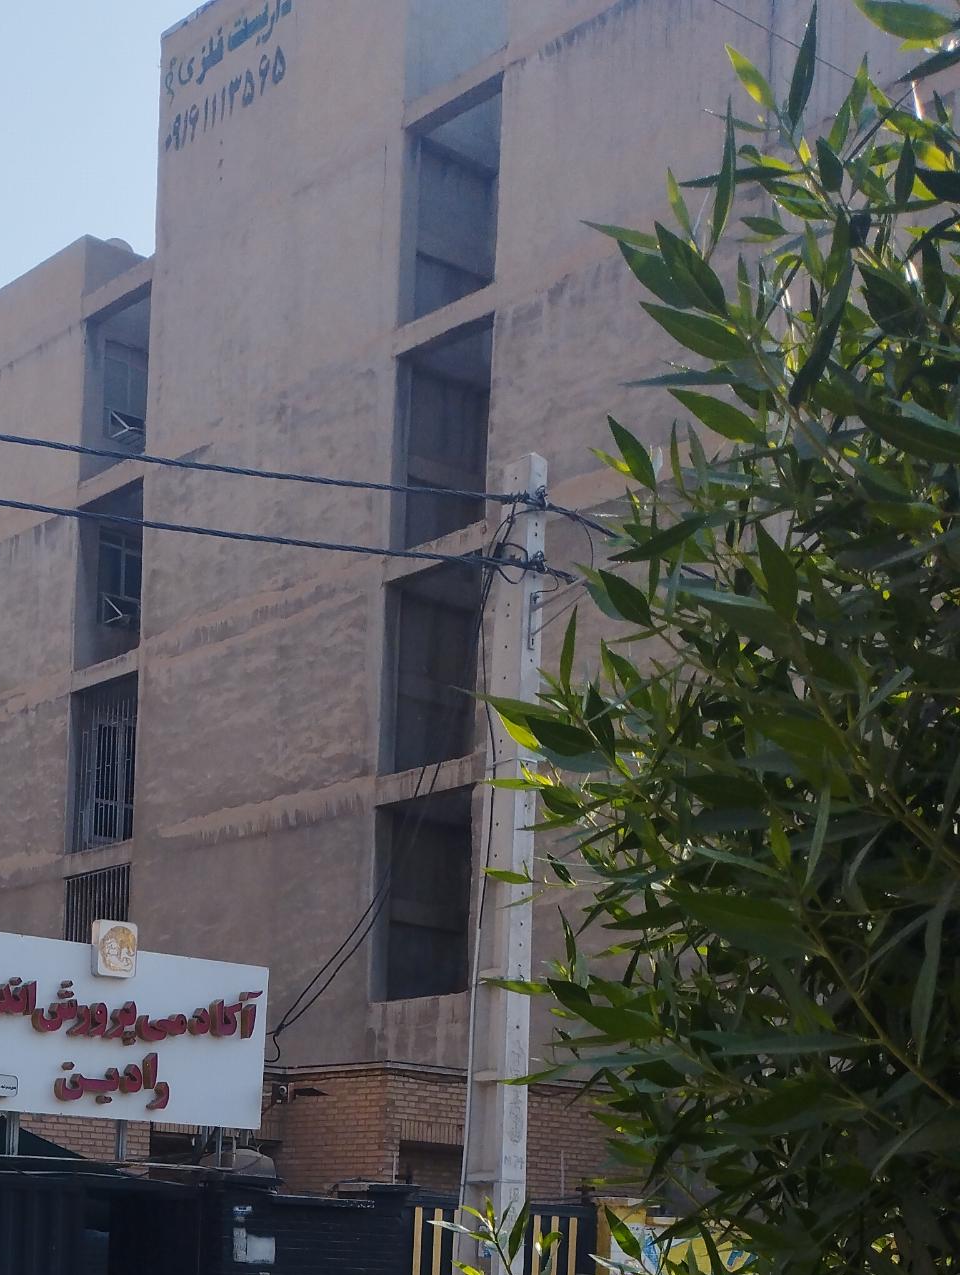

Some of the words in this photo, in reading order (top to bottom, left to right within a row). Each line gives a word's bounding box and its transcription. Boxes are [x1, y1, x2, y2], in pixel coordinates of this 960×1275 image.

[30, 980, 137, 1046] پرورش
[135, 990, 263, 1042] آکادمی
[53, 1052, 170, 1111] رادین
